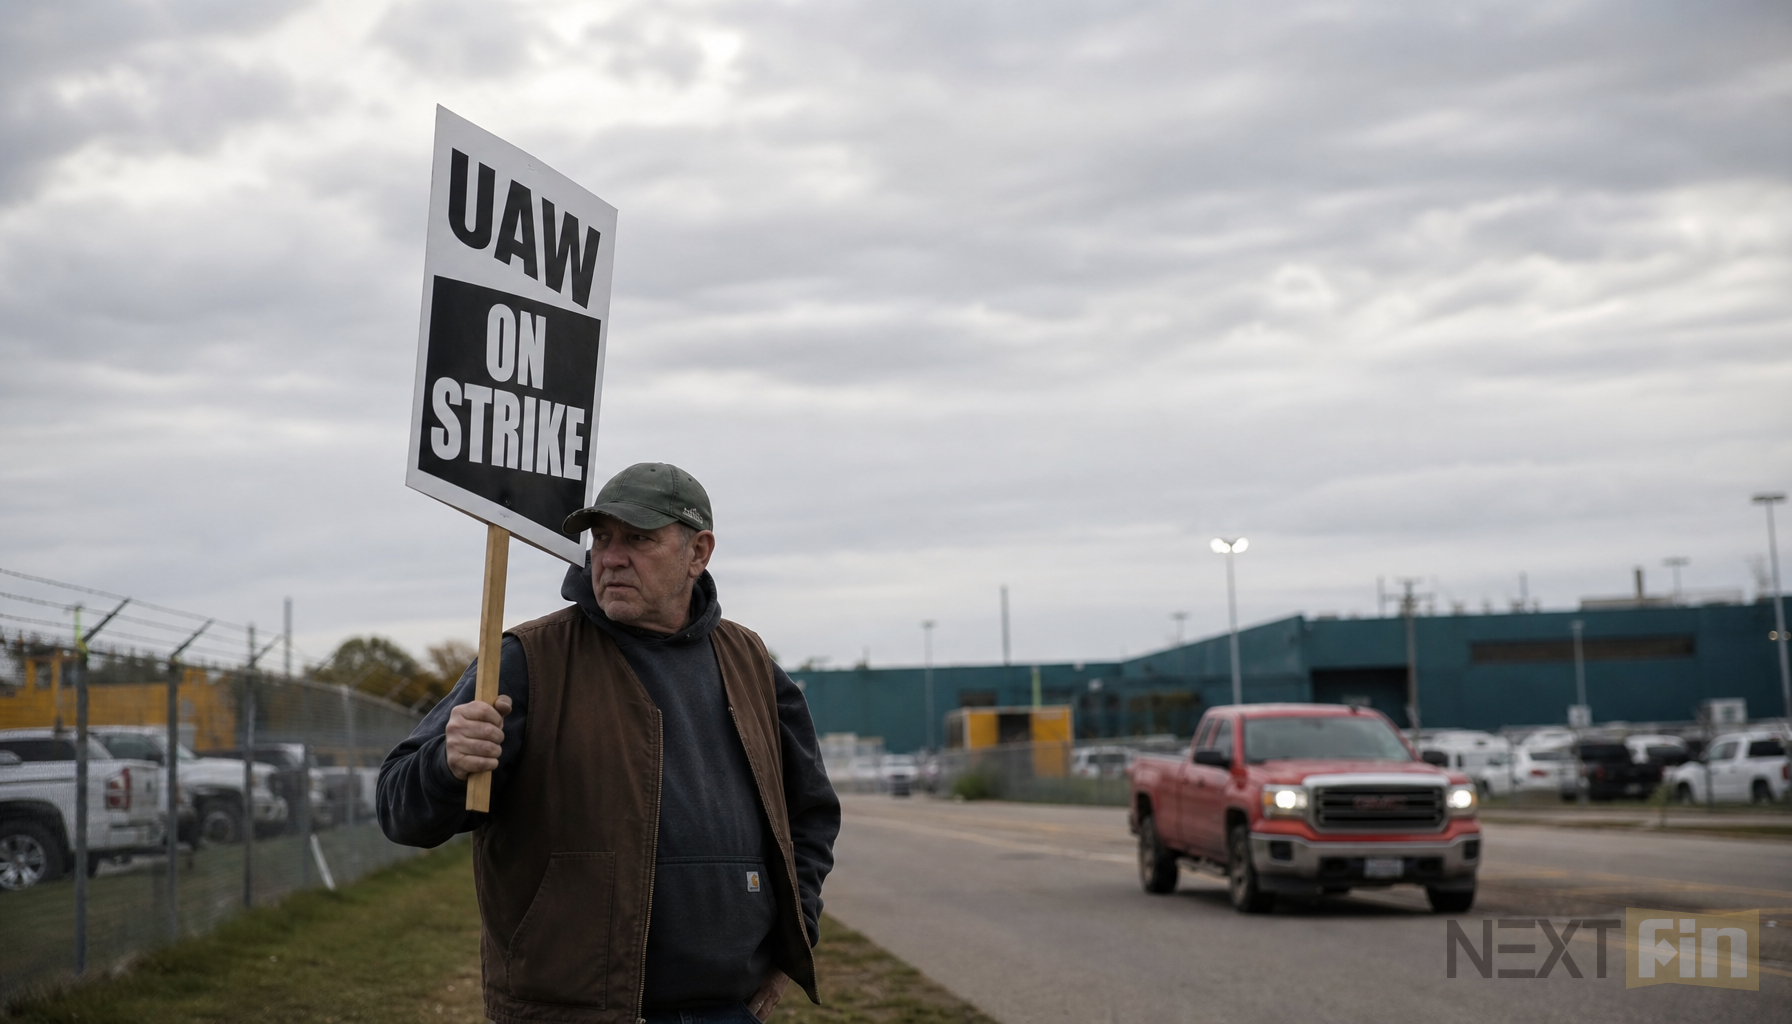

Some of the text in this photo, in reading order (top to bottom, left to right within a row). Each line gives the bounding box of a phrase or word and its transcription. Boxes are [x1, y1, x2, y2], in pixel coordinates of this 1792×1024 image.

[448, 147, 601, 309] UAW
[486, 303, 546, 389] ON
[430, 377, 585, 481] STRIKE
